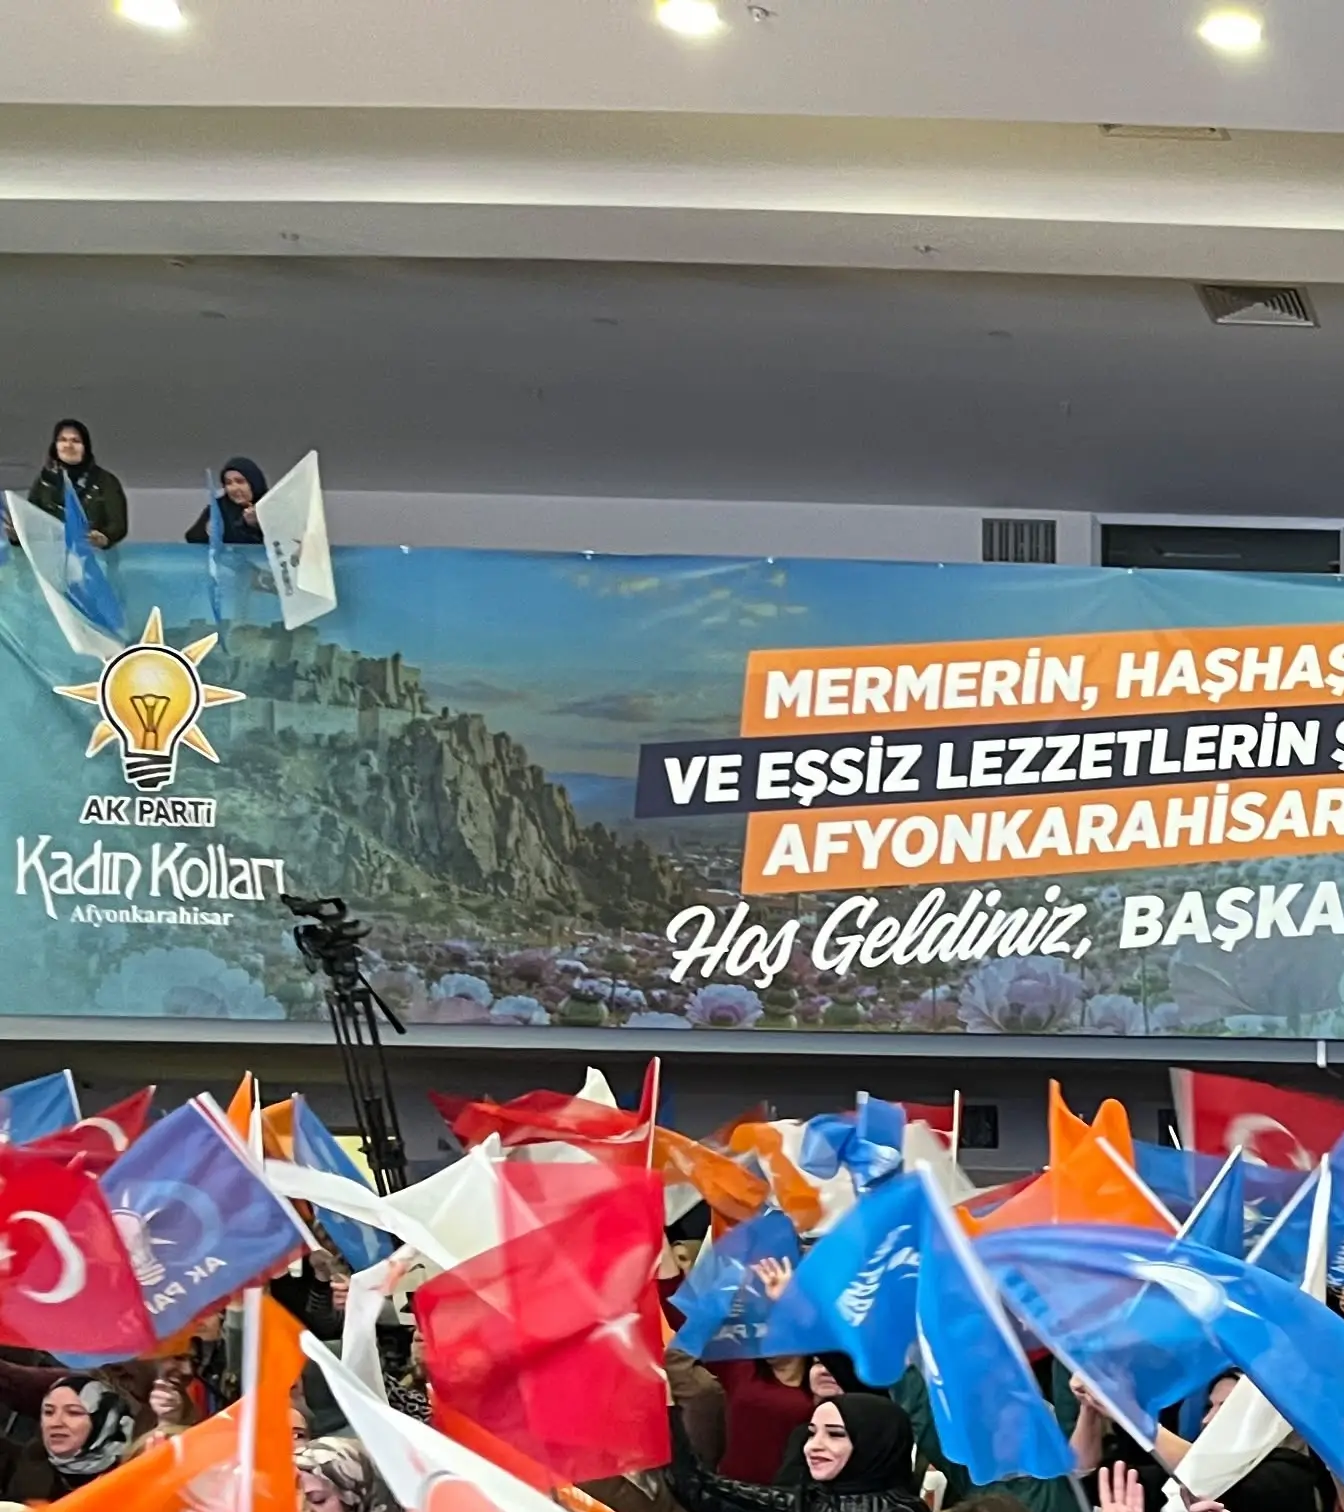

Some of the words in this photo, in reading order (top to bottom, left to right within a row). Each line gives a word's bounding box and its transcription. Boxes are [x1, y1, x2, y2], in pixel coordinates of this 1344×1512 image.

[764, 646, 1099, 720] MERMERİN,
[664, 754, 742, 806] VE
[756, 735, 923, 807] EŞSİZ
[936, 711, 1321, 791] LEZZETLERİN
[82, 798, 128, 824] AK
[16, 835, 142, 919] Kadın
[150, 842, 285, 901] Kolları
[70, 903, 235, 928] Afyonkarahisar
[665, 900, 800, 989] Hoş
[812, 884, 1092, 975] Geldiniz,
